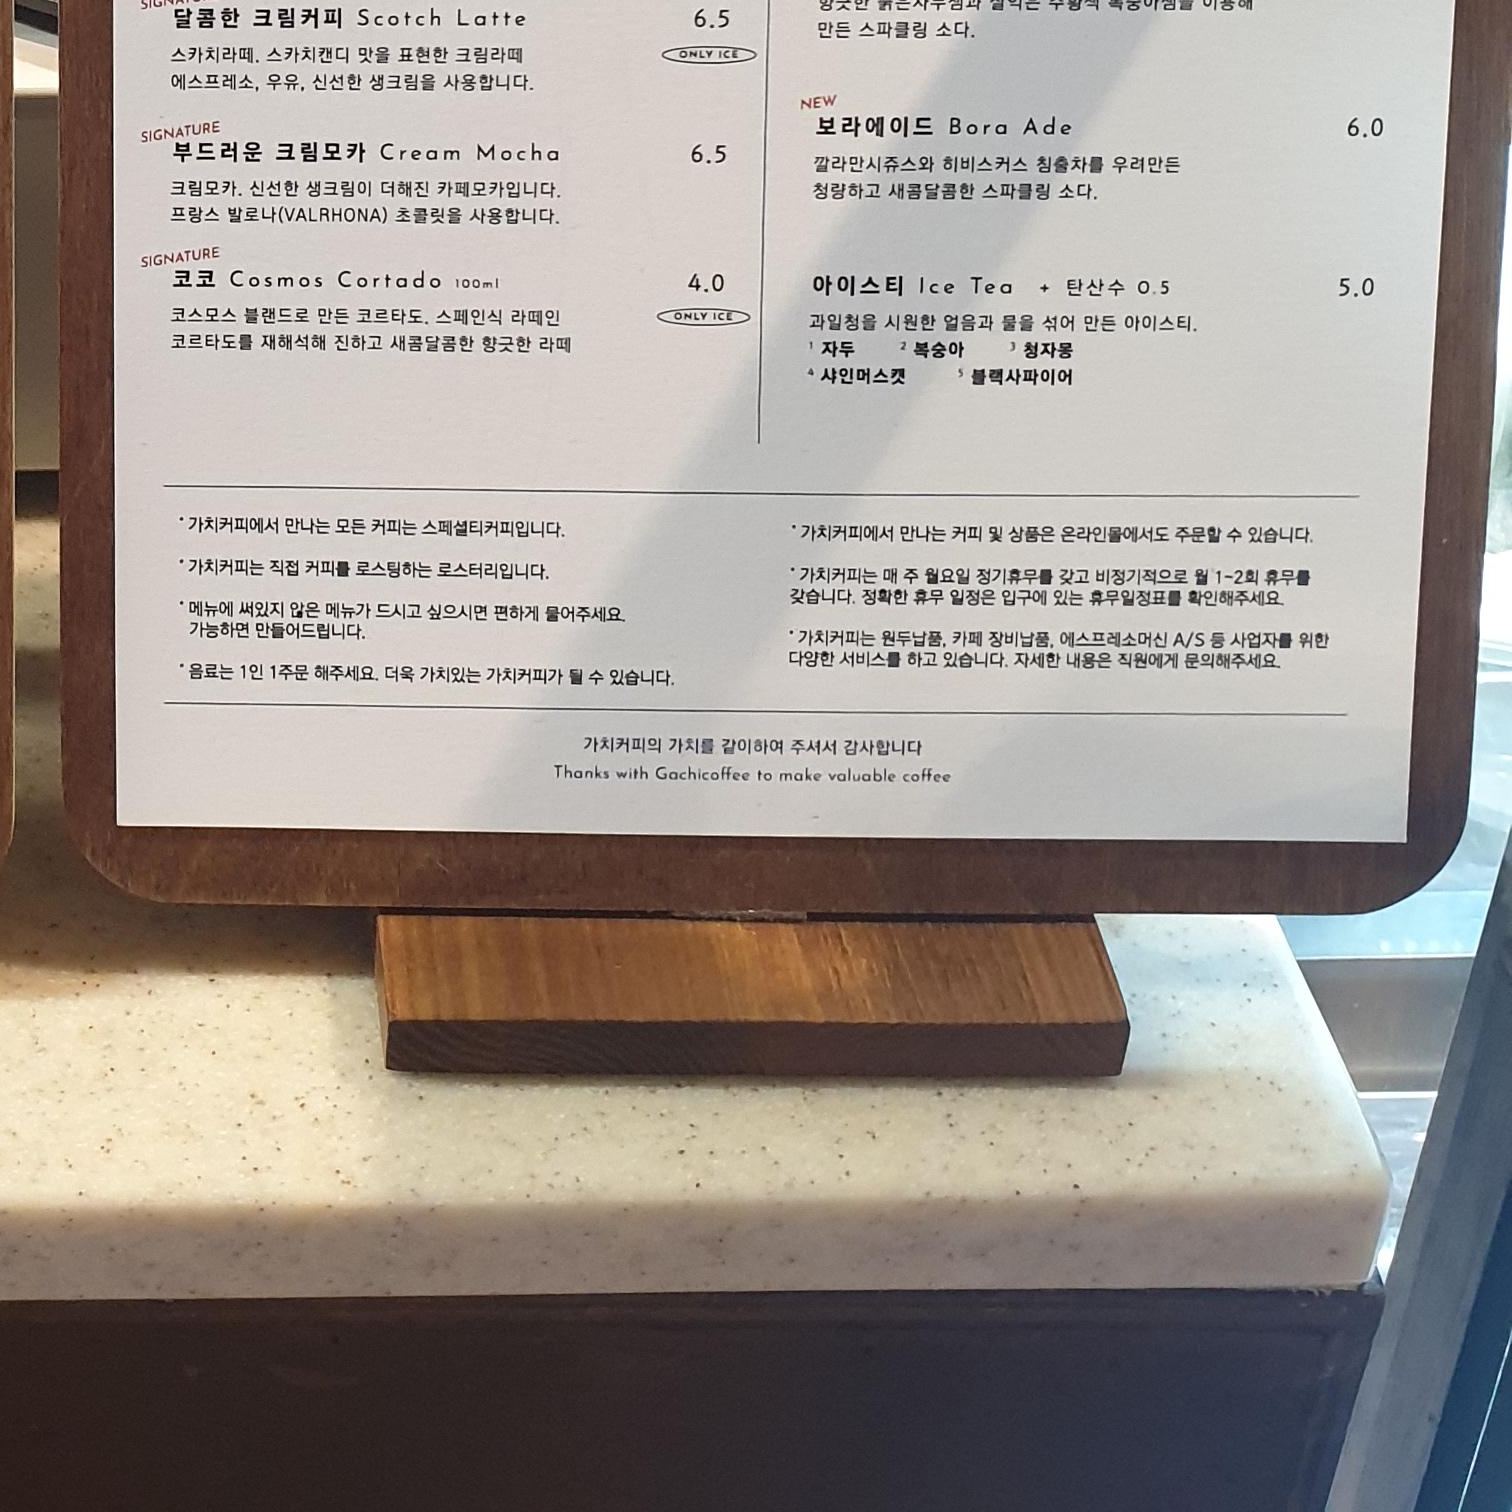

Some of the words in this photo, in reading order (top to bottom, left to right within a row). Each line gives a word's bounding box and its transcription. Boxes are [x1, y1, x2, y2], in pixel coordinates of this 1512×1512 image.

[174, 8, 240, 29] 달콤한
[253, 8, 341, 29] 크림커피
[357, 8, 440, 26] Scotch
[458, 9, 525, 26] Latte
[694, 9, 729, 28] 6.5
[679, 50, 713, 59] ONLY
[719, 50, 739, 59] ICE
[801, 95, 837, 109] NEW
[142, 121, 220, 143] SIGNATURE
[816, 116, 933, 138] 보라에이드
[950, 117, 1007, 135] Bora
[1023, 116, 1071, 135] Ade
[1348, 117, 1383, 138] 6.0
[173, 142, 262, 163] 부드러운
[276, 142, 366, 163] 크림모카
[380, 143, 460, 160] Cream
[477, 143, 559, 161] Mocha
[691, 144, 726, 164] 6.5
[141, 247, 219, 267] SIGNATURE
[173, 270, 215, 287] 코코
[230, 270, 322, 287] Cosmos
[338, 270, 441, 288] Cortado
[456, 278, 498, 288] 100ml
[688, 273, 724, 293] 4.0
[813, 275, 903, 296] 아이스티
[920, 277, 954, 294] Ice
[970, 277, 1012, 294] Tea
[1339, 278, 1374, 297] 5.0
[188, 517, 278, 534] 가치커피에서
[285, 518, 330, 534] 만나는
[335, 519, 366, 535] 모든
[371, 519, 418, 536] 커피는
[421, 520, 565, 538] 스페셜티커피입니다.
[554, 764, 609, 779] Thanks
[616, 765, 648, 779] with
[656, 766, 750, 781] Gachicoffee
[758, 770, 772, 781] to
[780, 767, 822, 782] make
[828, 768, 896, 782] valuable
[903, 768, 951, 783] coffee
